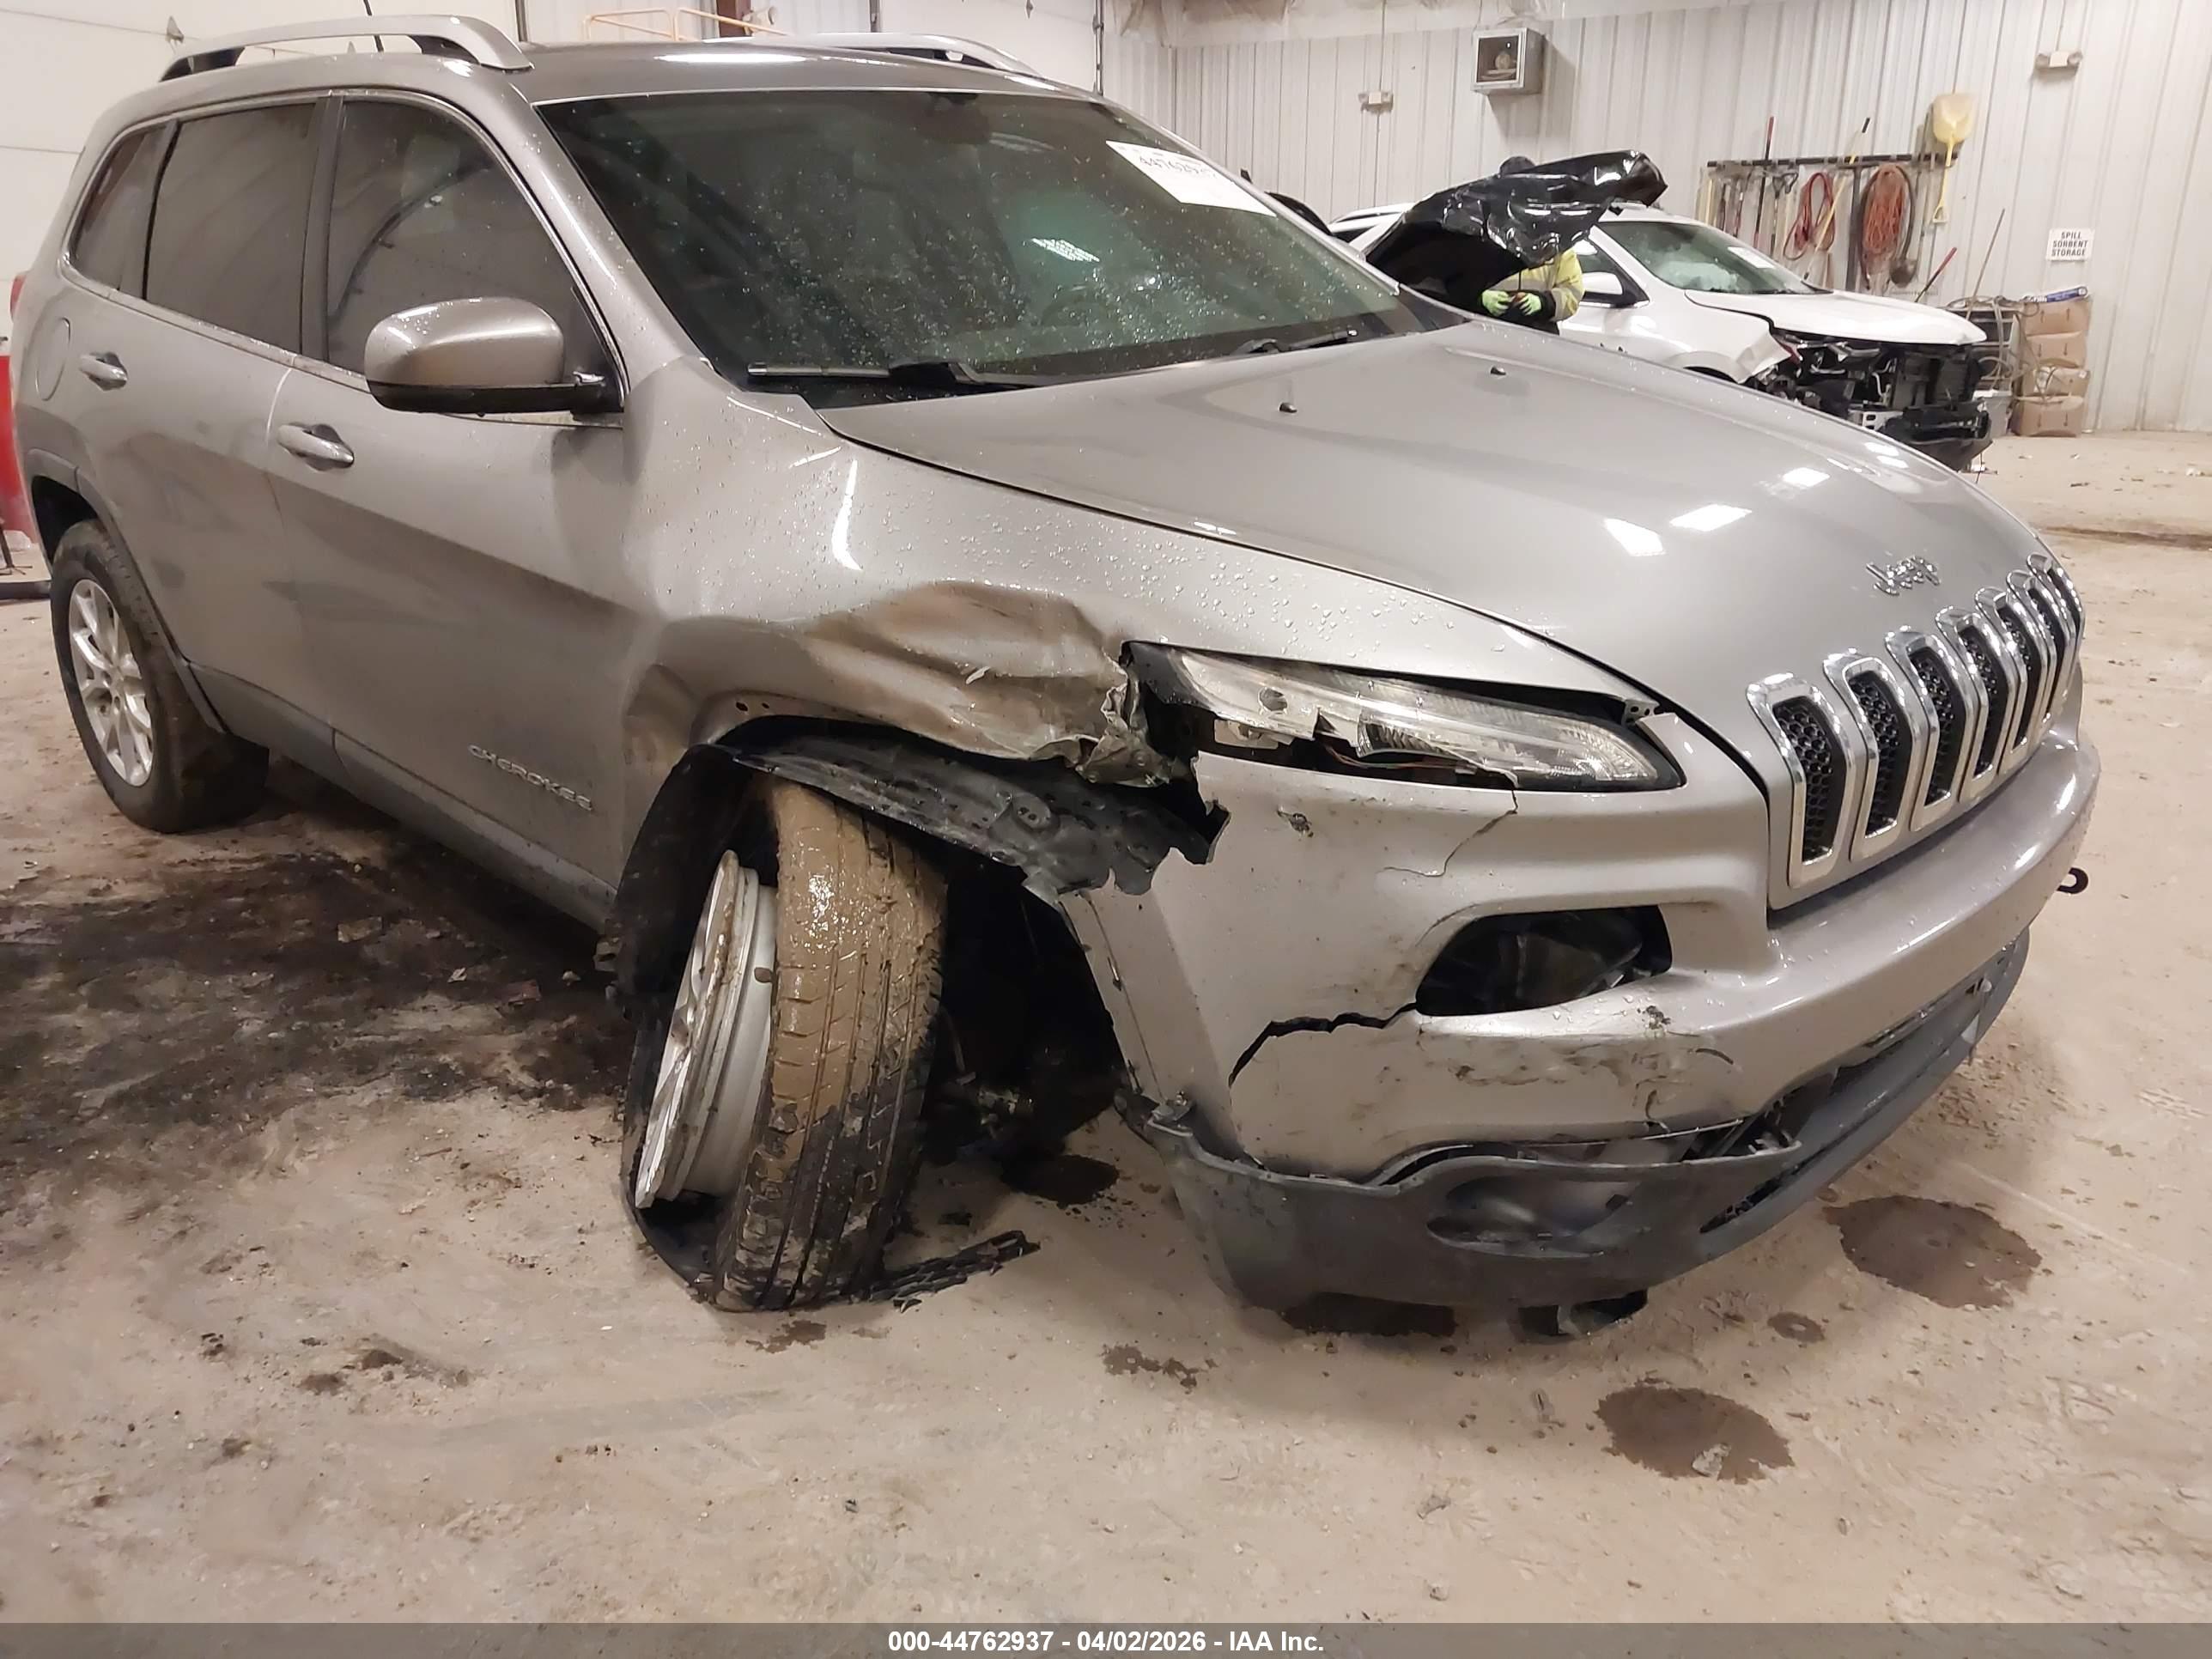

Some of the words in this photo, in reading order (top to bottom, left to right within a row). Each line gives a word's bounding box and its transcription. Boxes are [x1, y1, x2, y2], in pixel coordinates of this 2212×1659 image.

[2061, 231, 2081, 240] SPILL
[2053, 240, 2088, 248] SORBENT
[2051, 248, 2085, 257] STORAGE
[1866, 556, 1941, 596] Jeep
[468, 744, 592, 811] CHEROKEE
